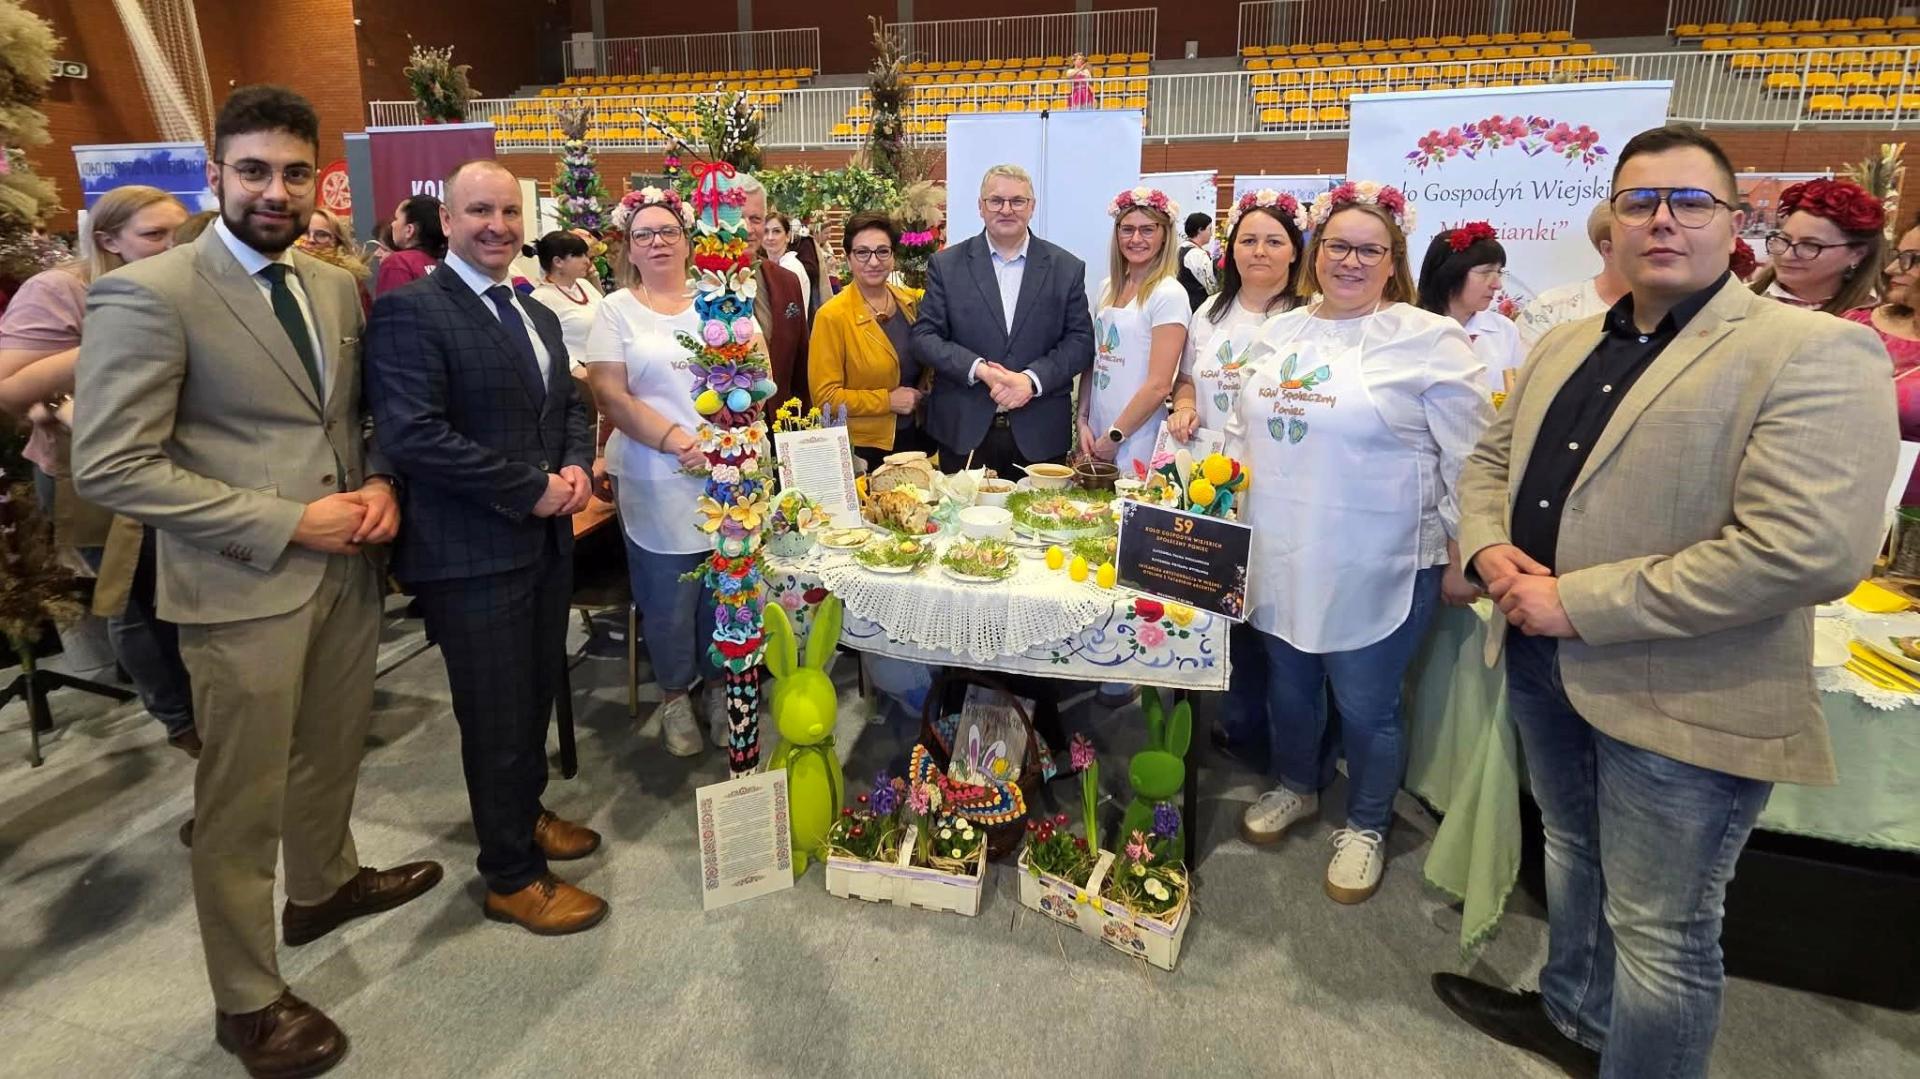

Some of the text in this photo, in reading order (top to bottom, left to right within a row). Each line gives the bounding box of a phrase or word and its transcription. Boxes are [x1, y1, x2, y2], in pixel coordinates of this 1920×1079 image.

[1425, 179, 1523, 208] Gospodyń
[1531, 176, 1612, 206] Wiejski
[1258, 388, 1279, 399] KGW
[1272, 401, 1305, 416] Poniec
[1173, 516, 1193, 534] 59
